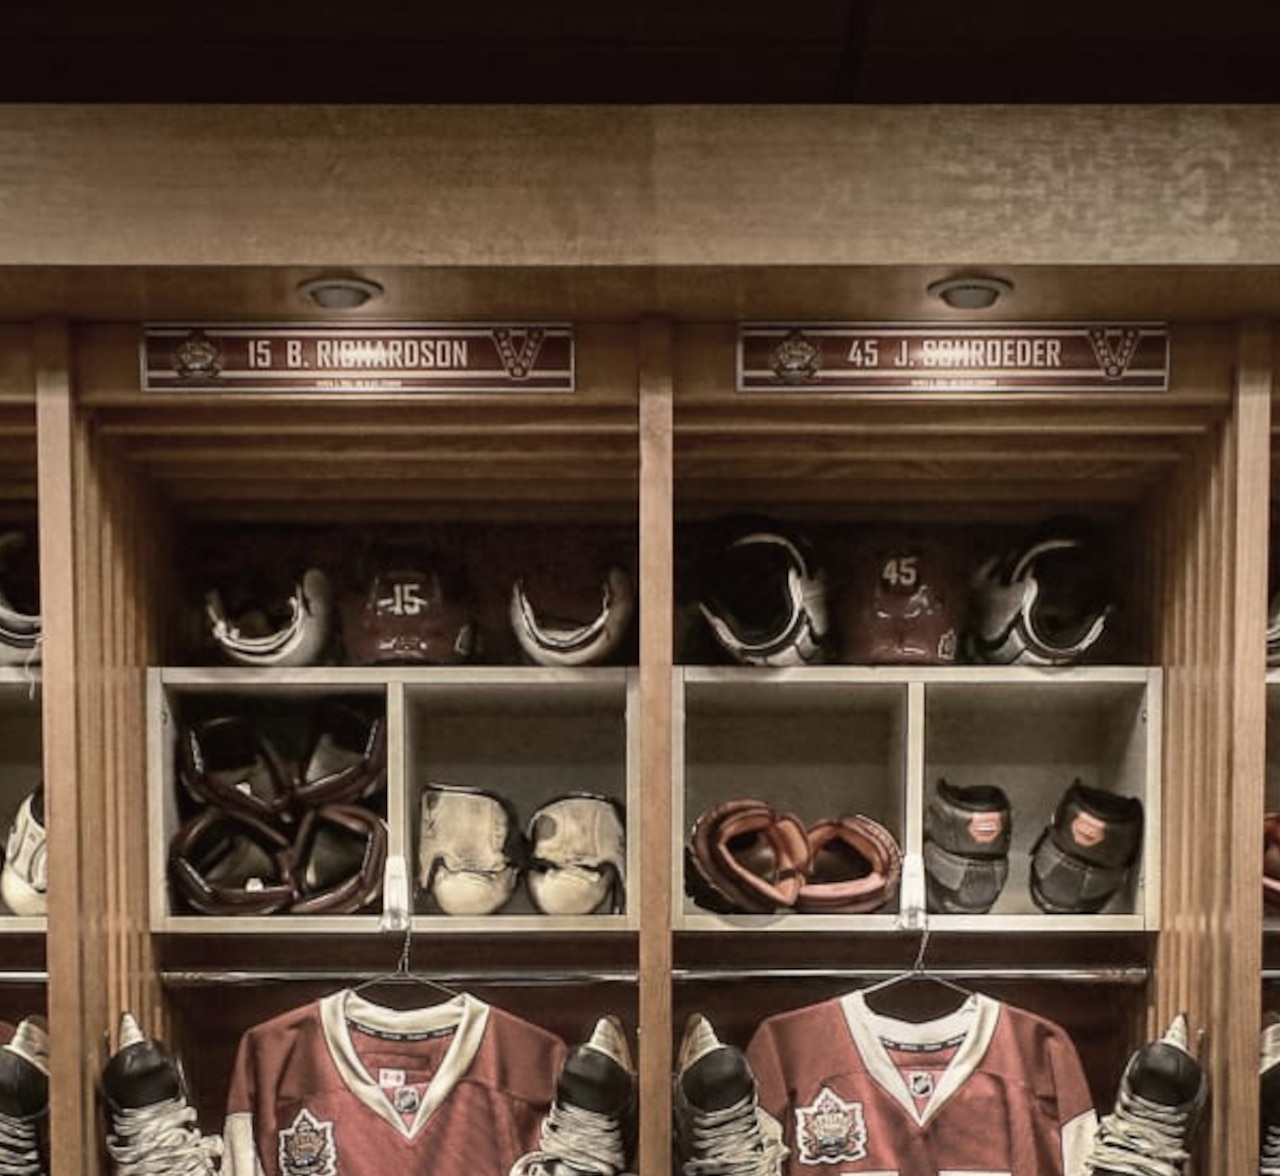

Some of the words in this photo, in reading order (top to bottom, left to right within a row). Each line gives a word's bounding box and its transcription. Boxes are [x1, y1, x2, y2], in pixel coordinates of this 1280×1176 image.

[247, 339, 272, 369] 15
[286, 339, 310, 369] B.
[316, 339, 469, 369] RICHARDSON
[847, 339, 879, 368] 45
[894, 339, 915, 368] J.
[881, 555, 919, 588] 45
[392, 582, 421, 616] 15
